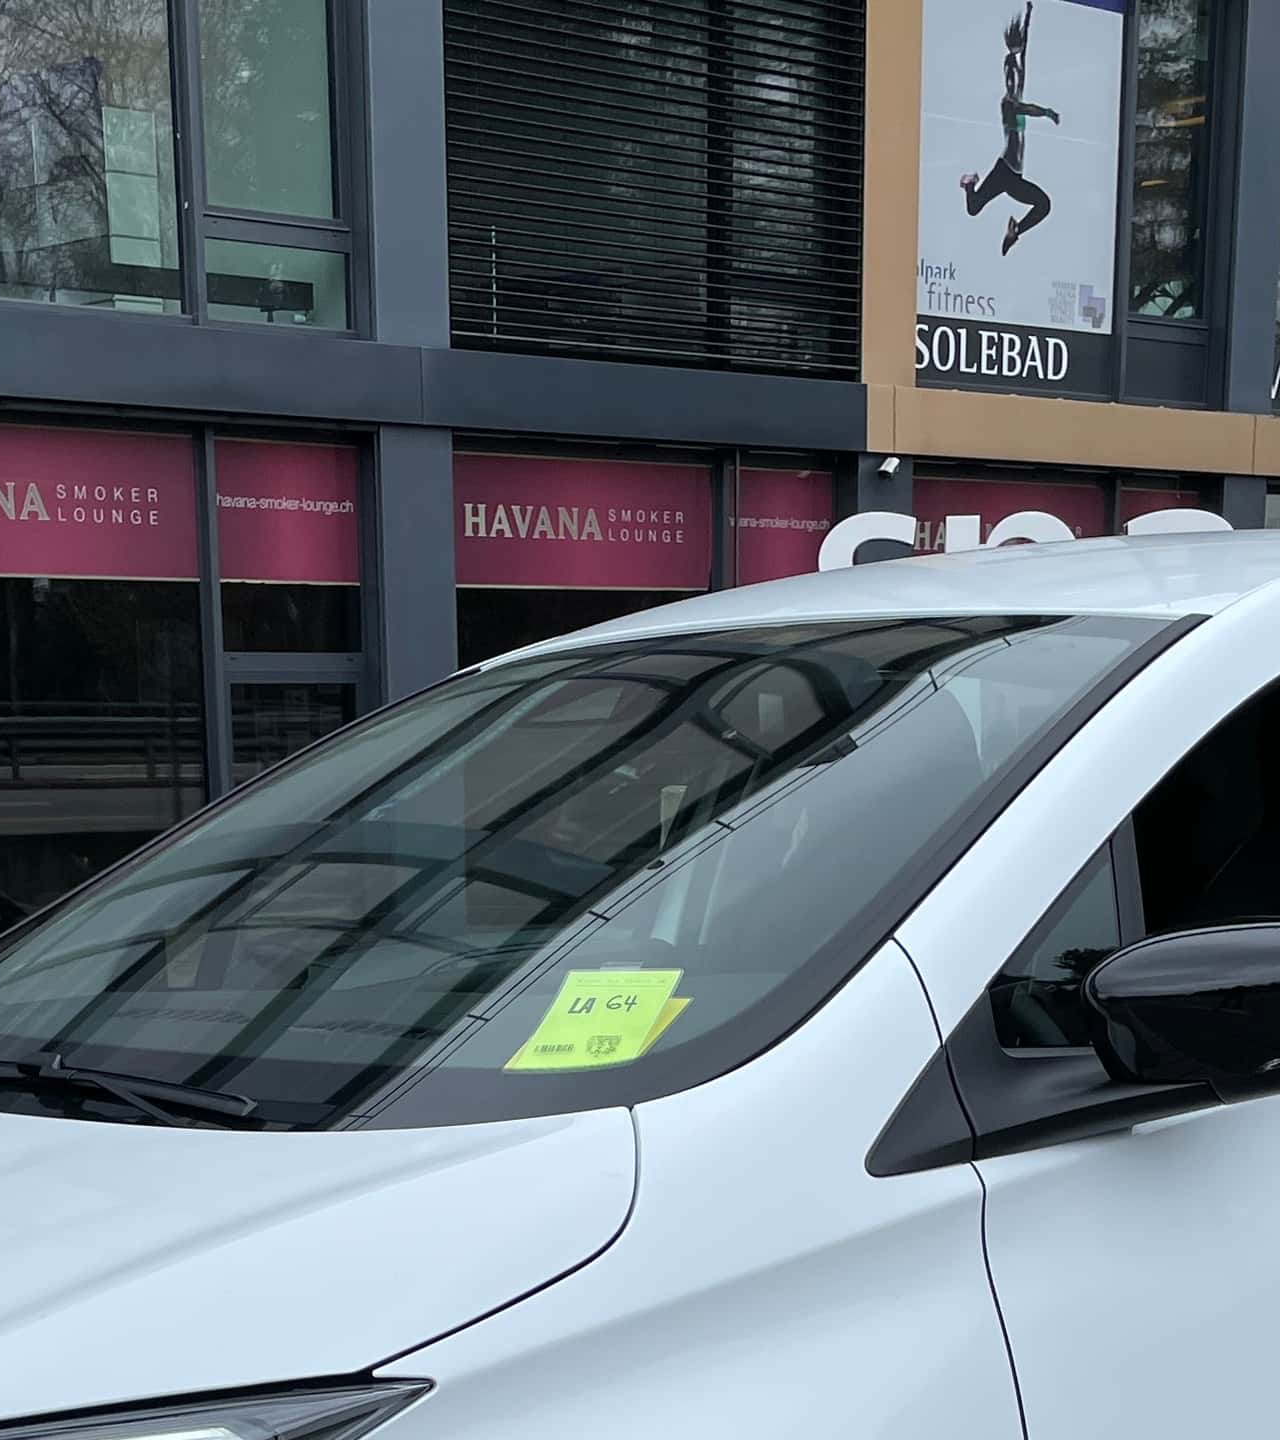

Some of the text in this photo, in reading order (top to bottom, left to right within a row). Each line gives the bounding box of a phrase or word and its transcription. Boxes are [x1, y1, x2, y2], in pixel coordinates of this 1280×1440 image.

[927, 281, 996, 316] fitness
[915, 323, 1069, 381] SOLEBAD
[55, 484, 159, 503] SMOKER
[215, 492, 355, 516] havana-smoker-lounge.ch
[56, 506, 160, 526] LOUNGE
[463, 502, 604, 541] HAVANA
[607, 508, 685, 525] SMOKER
[607, 527, 685, 544] LOUNGE
